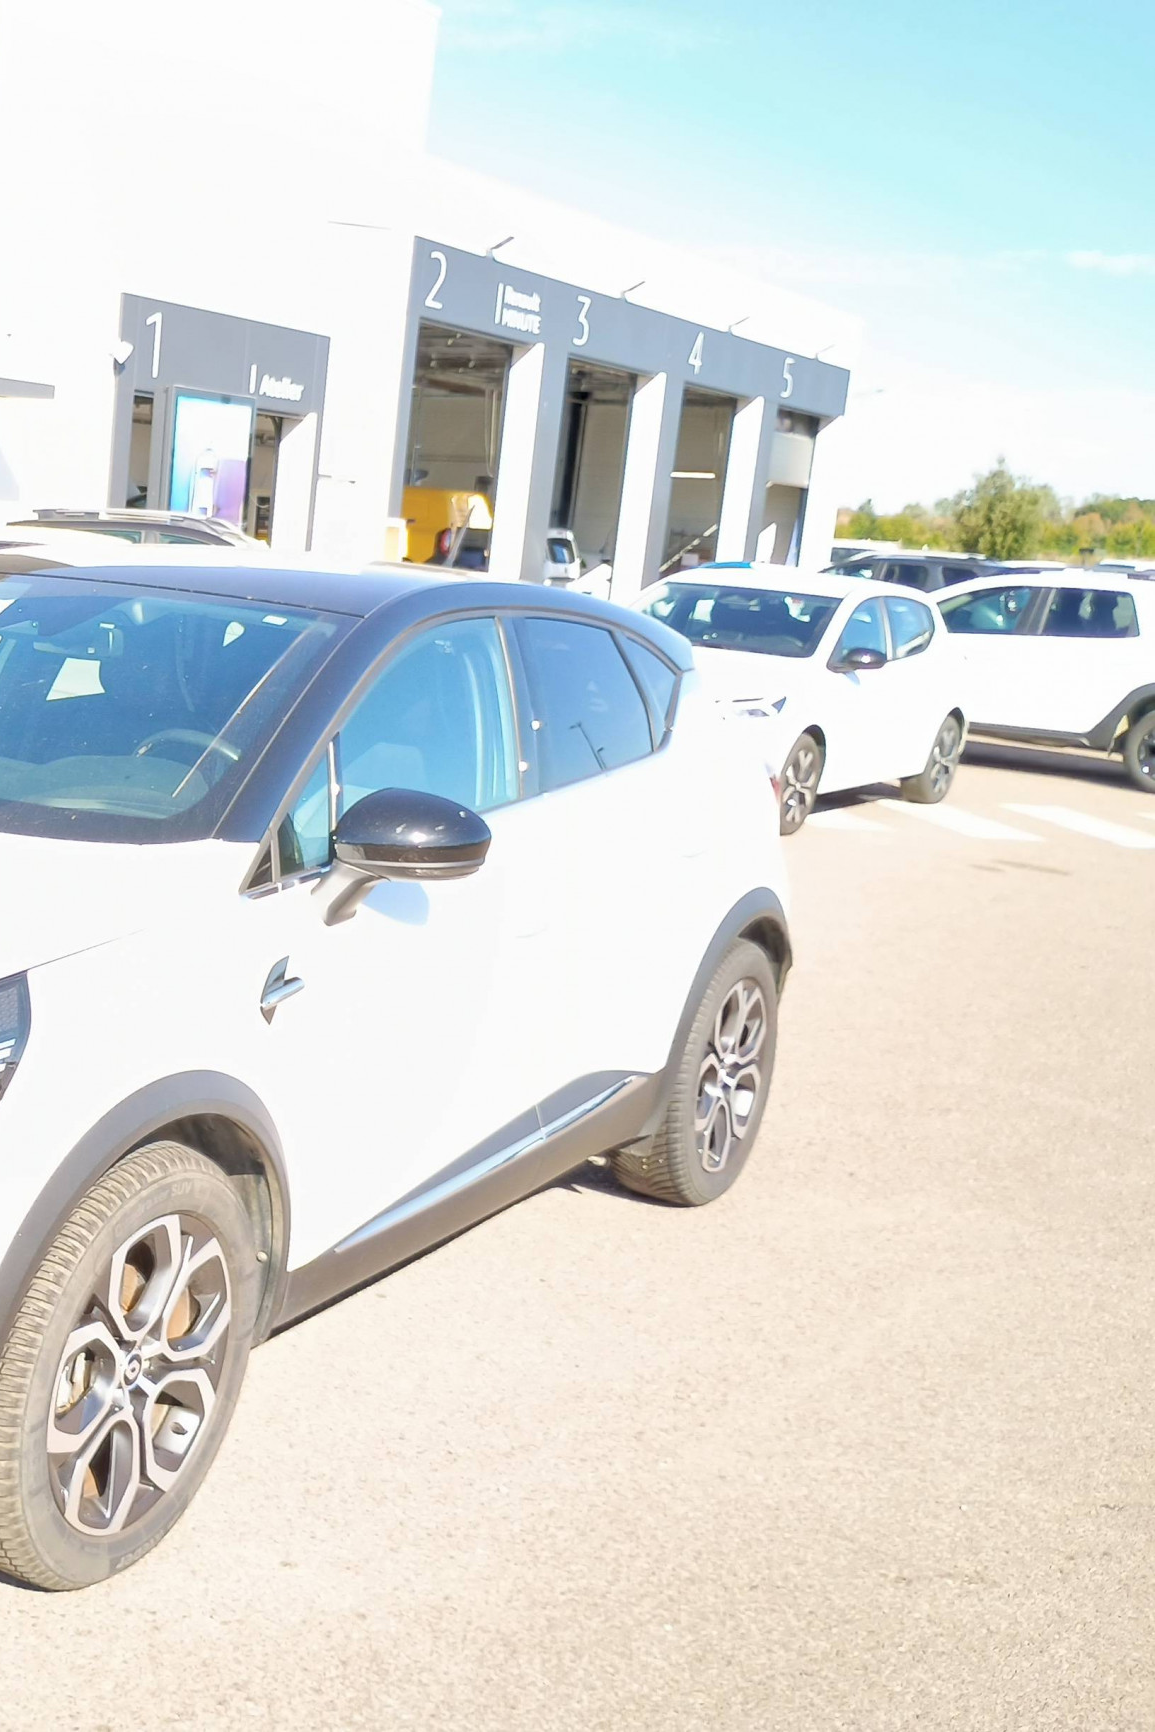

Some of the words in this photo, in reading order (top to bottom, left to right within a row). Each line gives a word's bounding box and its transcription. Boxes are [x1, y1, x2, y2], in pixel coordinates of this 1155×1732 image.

[424, 251, 448, 309] 2
[146, 312, 163, 378] 1
[573, 295, 591, 346] 3
[688, 331, 705, 375] 4
[780, 356, 796, 399] 5
